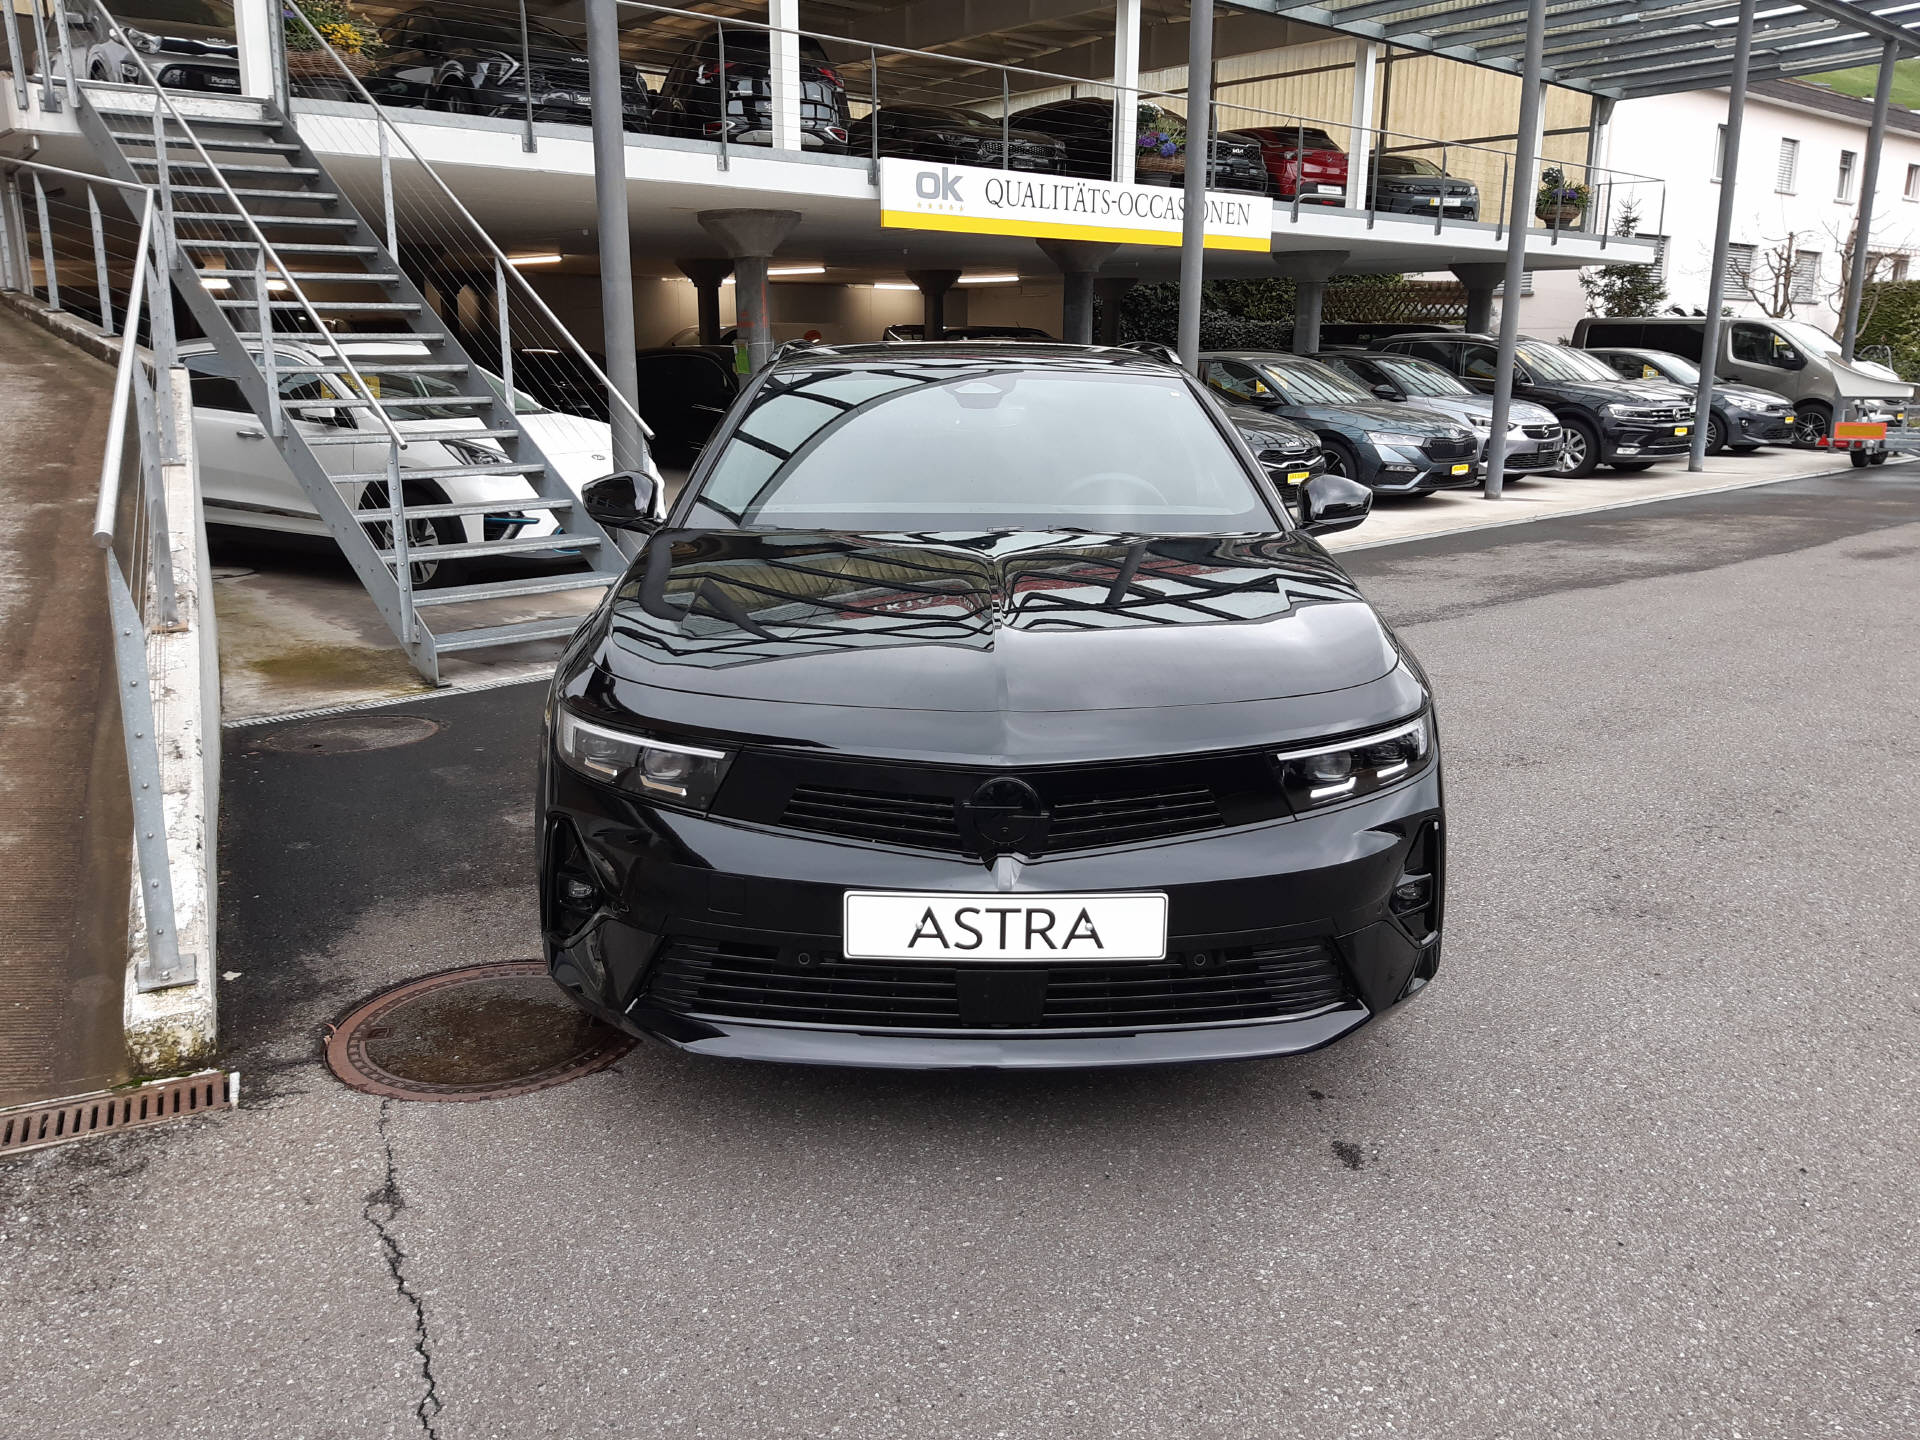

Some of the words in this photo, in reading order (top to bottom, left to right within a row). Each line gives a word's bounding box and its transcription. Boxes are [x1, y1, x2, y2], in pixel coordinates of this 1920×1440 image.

[211, 76, 236, 84] Picanto
[916, 166, 964, 202] ok
[984, 178, 1251, 227] QUALITÄTS-OCCASNEN
[907, 906, 1105, 950] ASTRA
